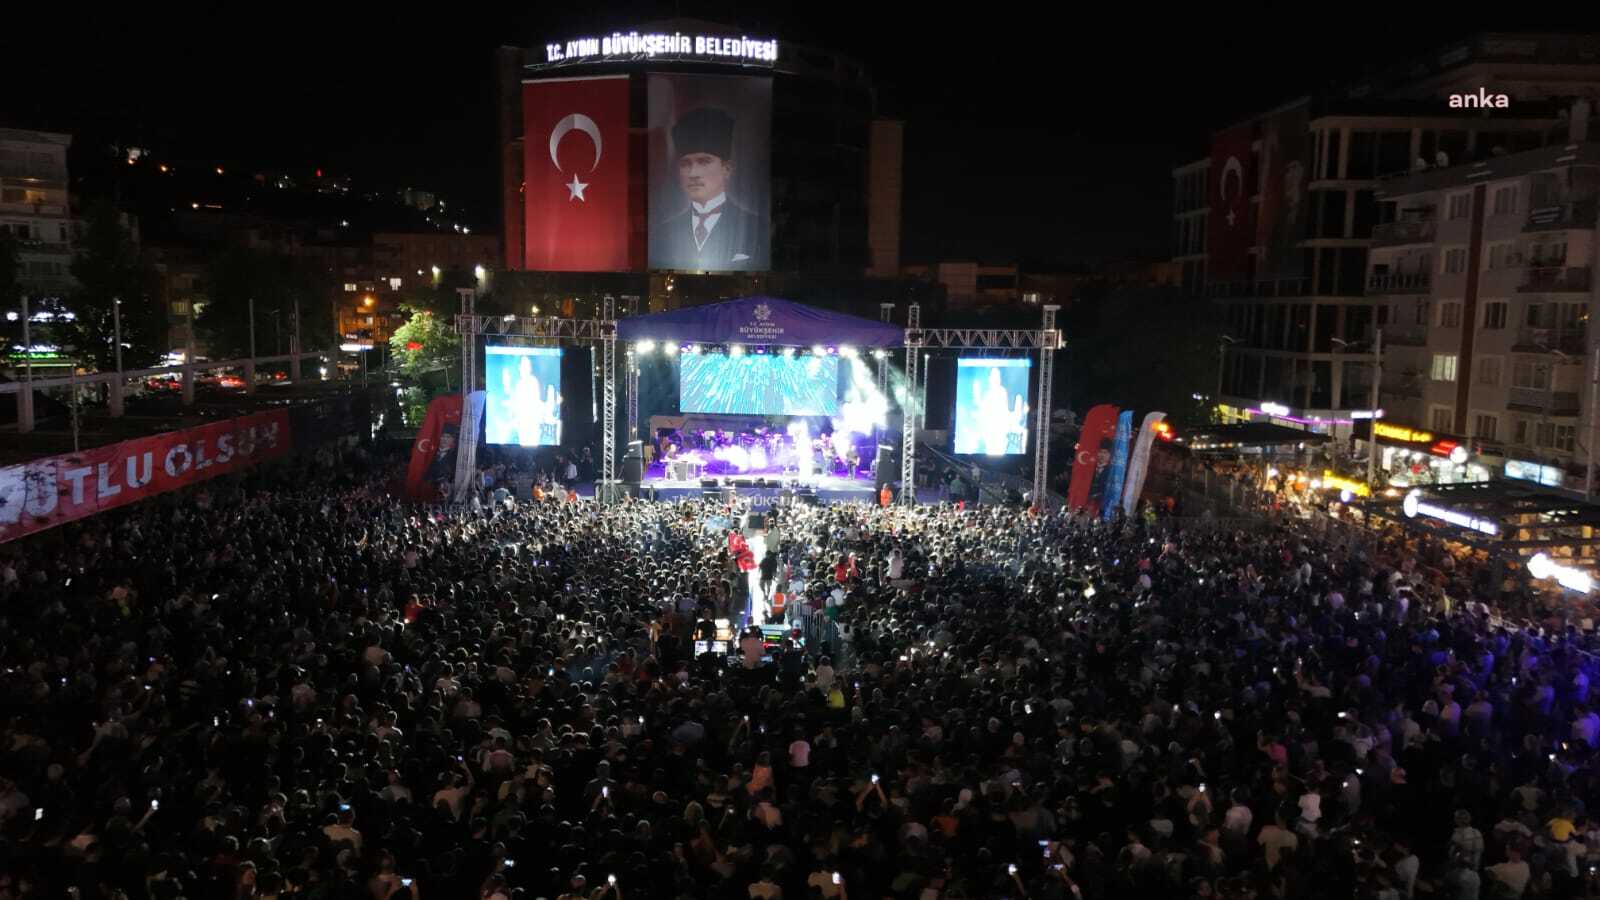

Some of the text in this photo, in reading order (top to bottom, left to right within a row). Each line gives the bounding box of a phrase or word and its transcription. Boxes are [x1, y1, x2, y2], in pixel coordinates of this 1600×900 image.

[546, 31, 777, 62] T.C. AYDIN BÜYÜKŞEHİR BELEDİYESİ
